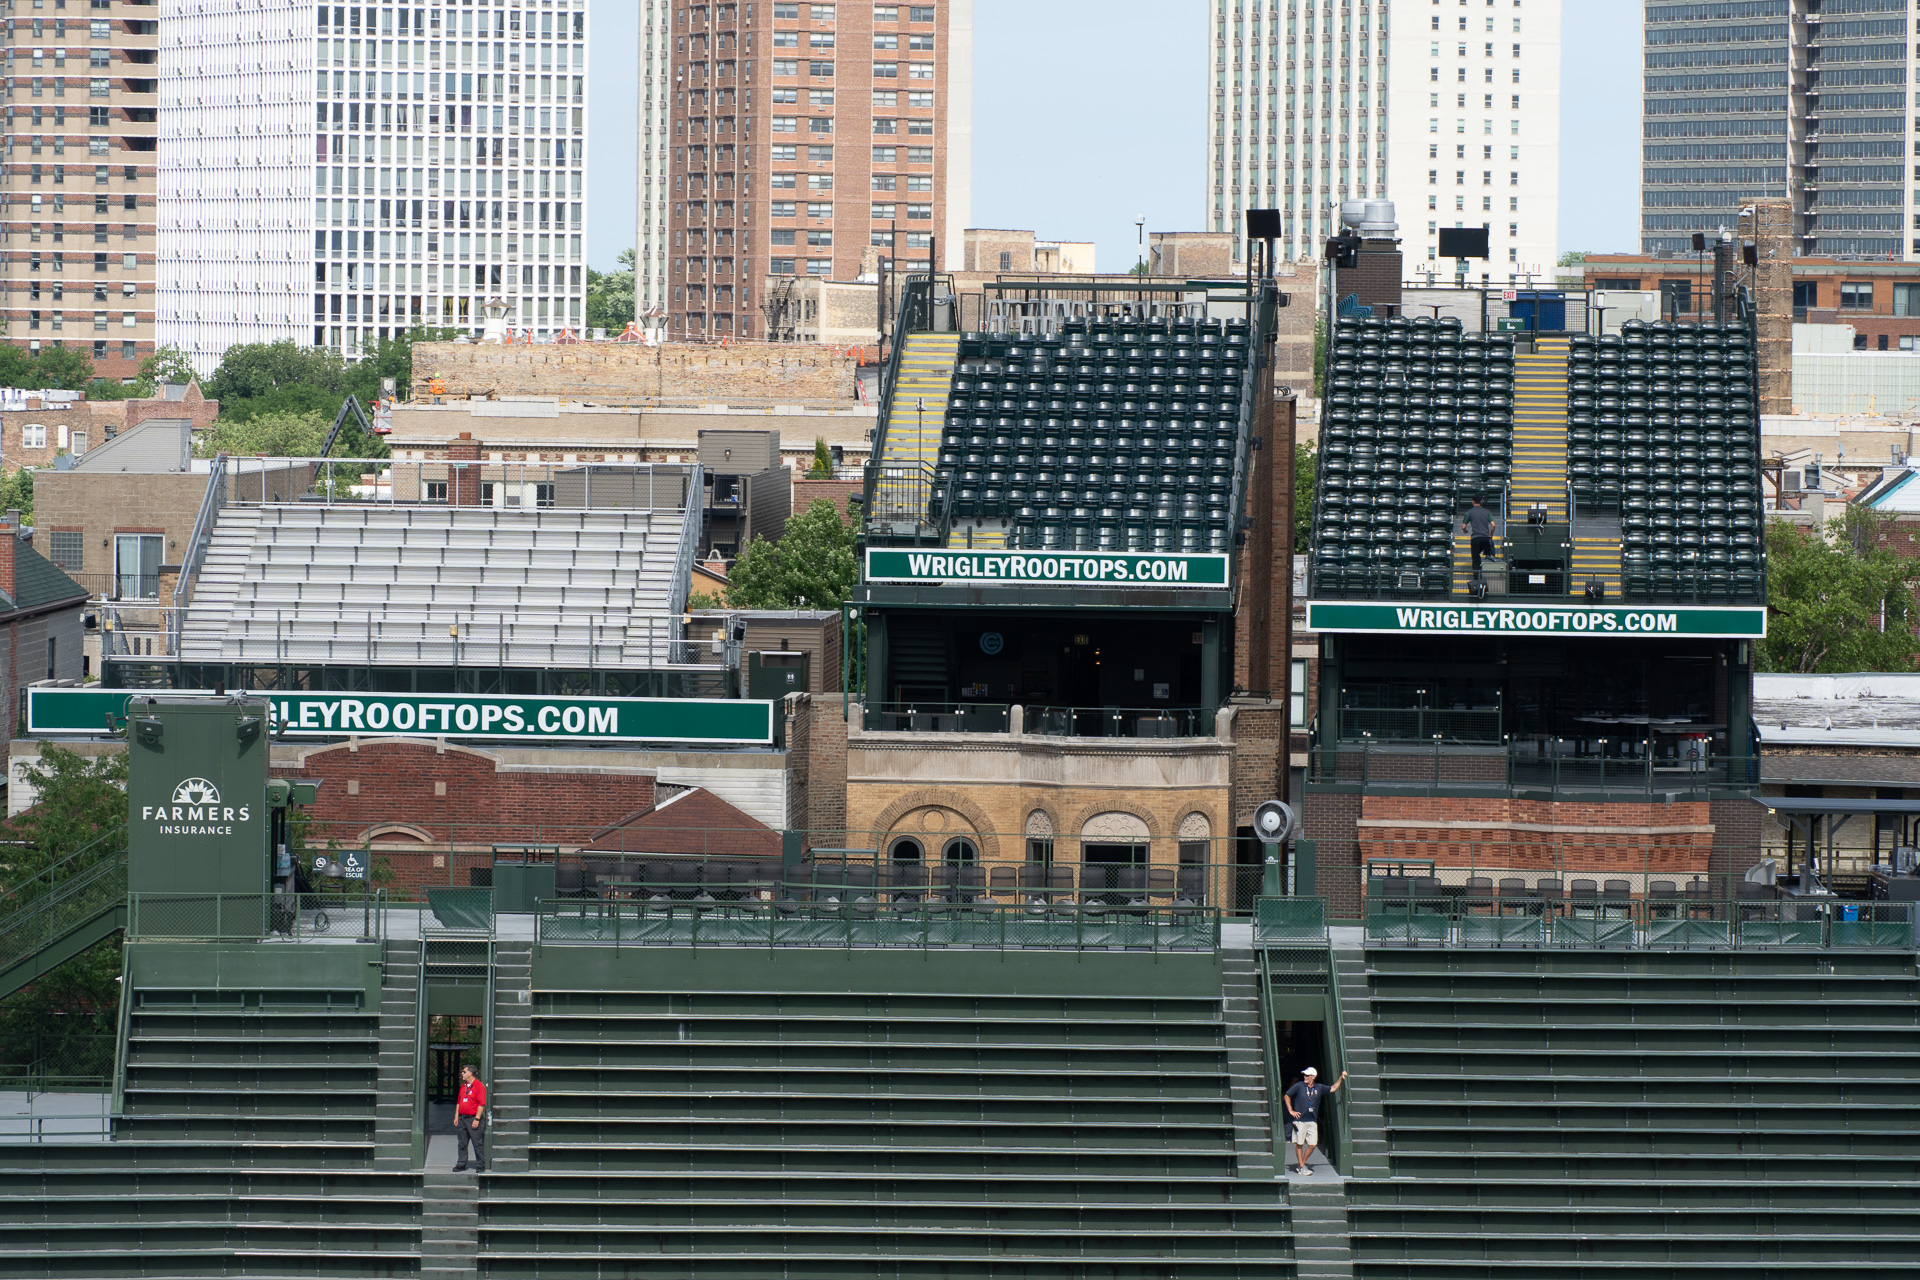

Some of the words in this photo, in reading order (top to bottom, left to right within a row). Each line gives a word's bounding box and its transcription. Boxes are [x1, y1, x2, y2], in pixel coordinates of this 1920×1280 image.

[1503, 291, 1515, 300] EXIT
[908, 554, 1188, 581] WRIGLEYROOFTOPS.COM
[1396, 608, 1677, 632] WRIGLEYROOFTOPS.COM
[142, 806, 250, 821] FARMERS
[160, 825, 232, 835] INSURANCE
